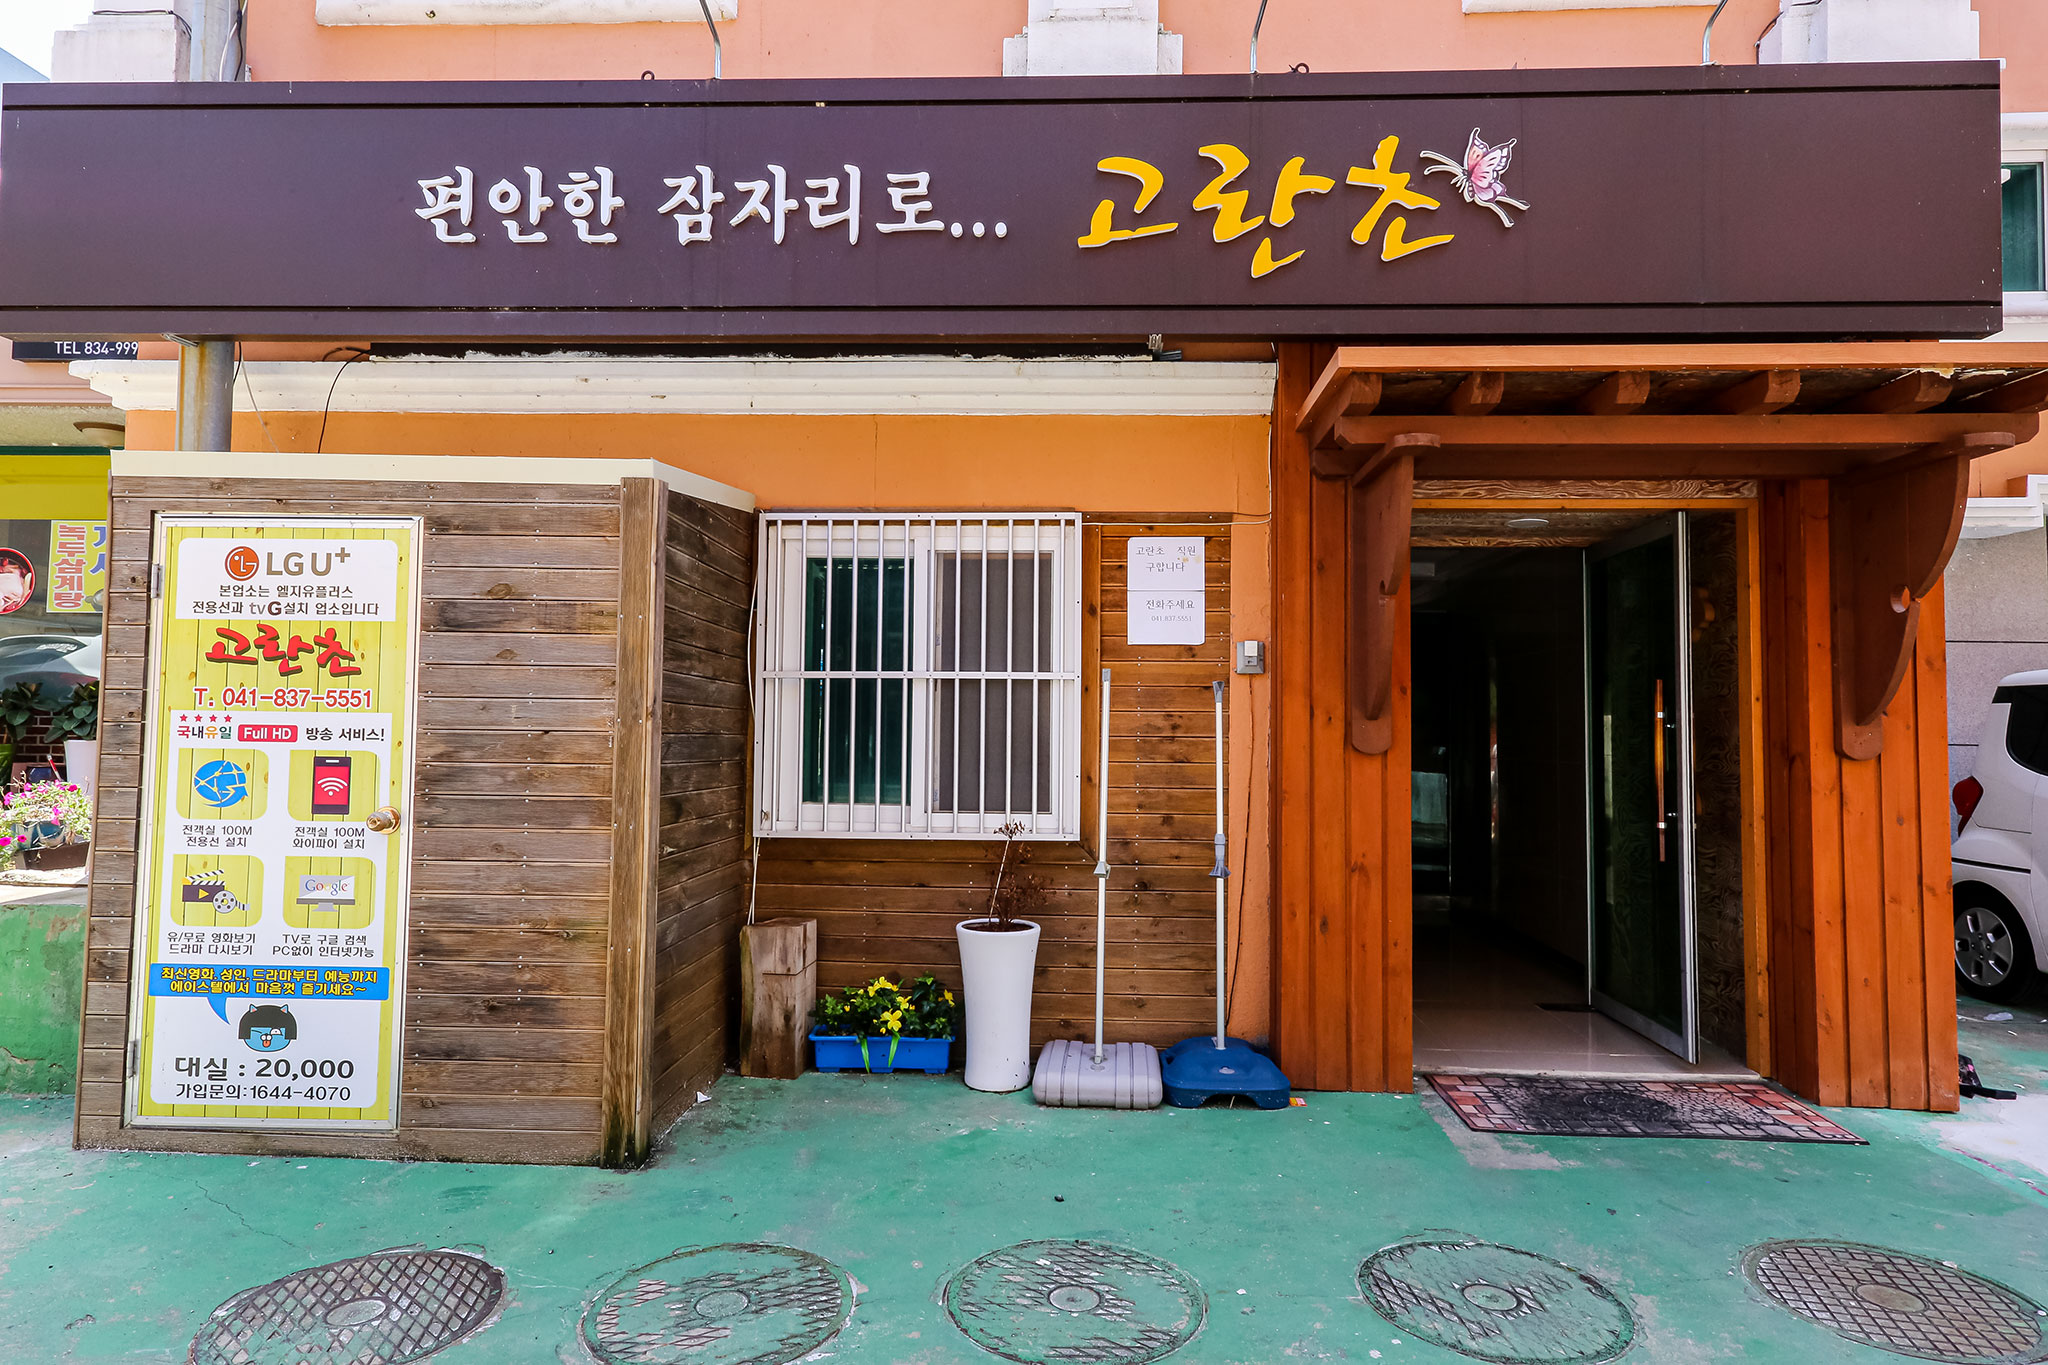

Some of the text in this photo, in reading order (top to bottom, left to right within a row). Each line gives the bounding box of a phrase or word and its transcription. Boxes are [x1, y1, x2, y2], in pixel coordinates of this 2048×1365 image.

[415, 163, 1008, 246] 편안한 잠자리로...
[54, 341, 81, 355] TEL
[1177, 545, 1196, 557] 직원
[53, 523, 87, 609] 녹두삼계탕
[1146, 561, 1185, 572] 구합니다
[219, 584, 354, 600] 본업소는 엘지유플러스
[192, 600, 244, 615] 전용선과
[315, 602, 380, 617] 업소입니다
[1146, 599, 1196, 610] 전화주세요
[193, 687, 373, 709] T. 041-837-5551
[177, 725, 385, 742] 국내유일 Full HD 방송 서비스!
[182, 824, 253, 837] 전객실 100M
[294, 826, 365, 838] 전객실 100M
[186, 836, 247, 848] 전용선 설치
[292, 838, 365, 850] 와이파이 설치
[305, 878, 349, 897] Google
[167, 931, 256, 944] 유/무료 영화보기
[282, 933, 367, 946] TV로 구글 검색
[169, 943, 253, 956] 드라마 다시보기
[272, 945, 375, 958] PC없이 인터넷가능
[252, 968, 319, 983] 드라마부터
[324, 969, 378, 984] 예능까지
[169, 979, 250, 994] 에이스텔에서
[255, 981, 296, 996] 마음껏
[174, 1057, 229, 1082] 대실
[255, 1057, 355, 1082] 20,000
